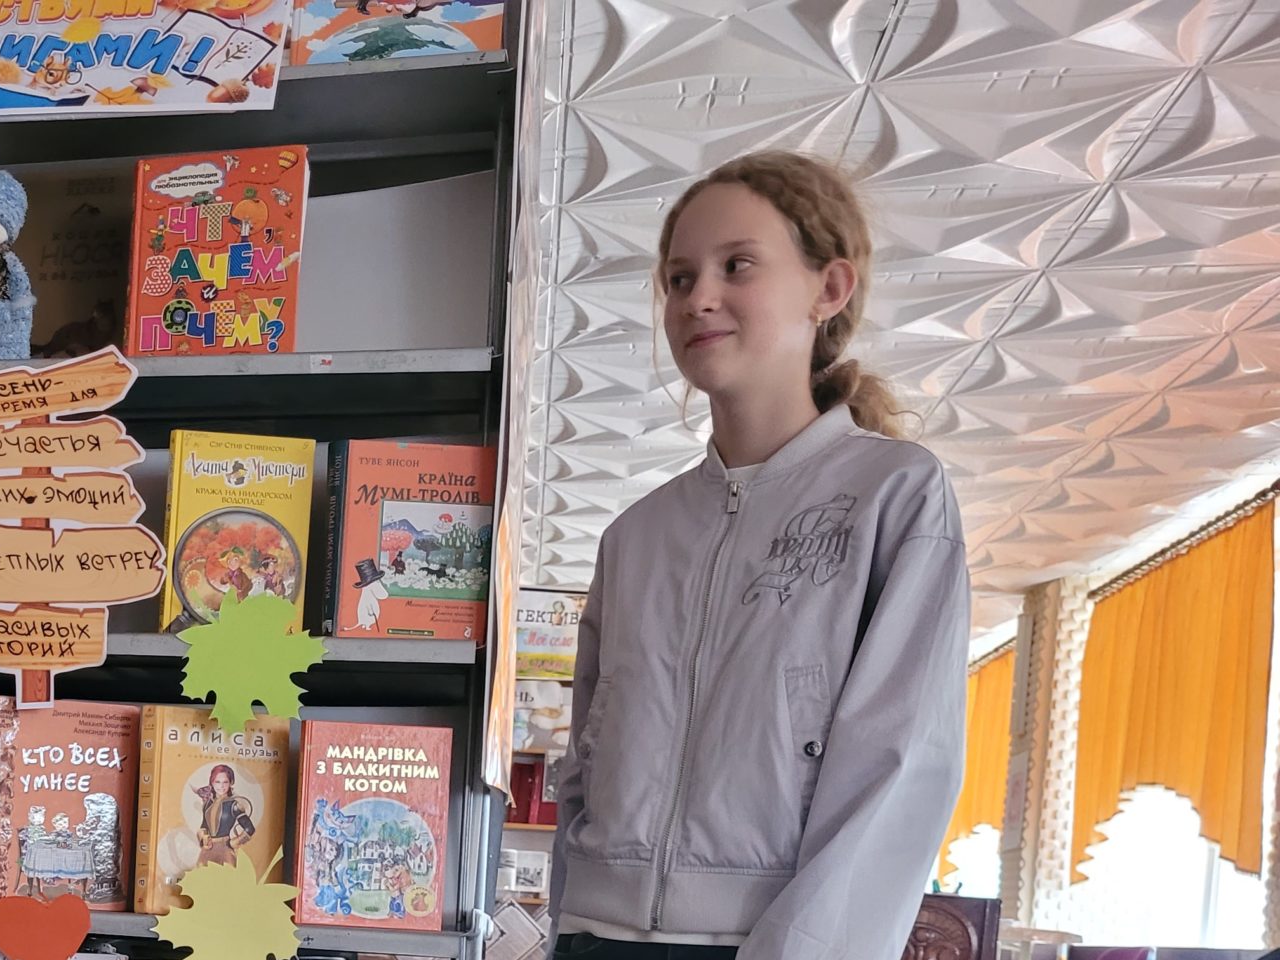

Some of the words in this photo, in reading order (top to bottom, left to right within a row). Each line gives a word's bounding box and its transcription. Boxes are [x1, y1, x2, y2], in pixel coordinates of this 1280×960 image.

[141, 242, 287, 296] ЗАЧЕМ
[140, 297, 287, 352] ПОЧЕМУ?
[385, 458, 419, 467] ЯНСОН
[22, 744, 64, 767] КТО
[69, 742, 127, 772] ВСЕХ
[237, 749, 279, 760] друзья
[327, 745, 428, 763] МАНДРІВКА
[333, 762, 440, 779] БЛАКИТНИМ
[21, 773, 92, 794] УМНЕЕ
[344, 778, 408, 794] КОТОМ
